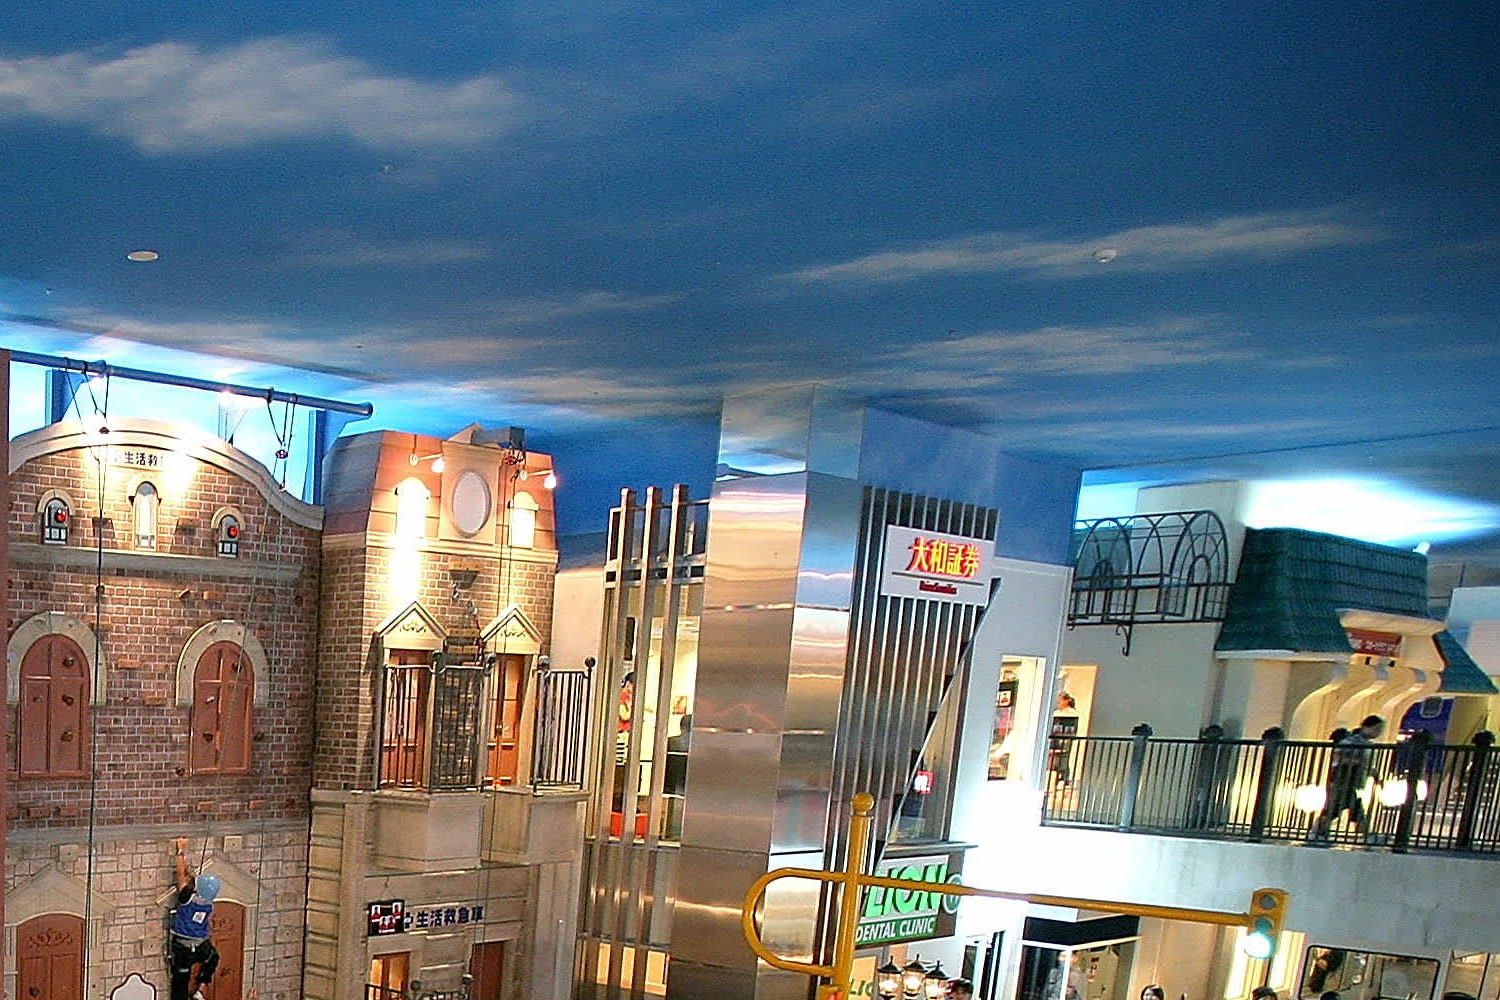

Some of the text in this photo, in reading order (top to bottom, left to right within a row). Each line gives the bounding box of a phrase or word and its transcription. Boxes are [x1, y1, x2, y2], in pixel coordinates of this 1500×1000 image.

[906, 537, 981, 578] 大和証券
[863, 864, 949, 917] LION
[416, 906, 484, 928] 生活救急車
[856, 917, 936, 942] DENTAL CLINIC
